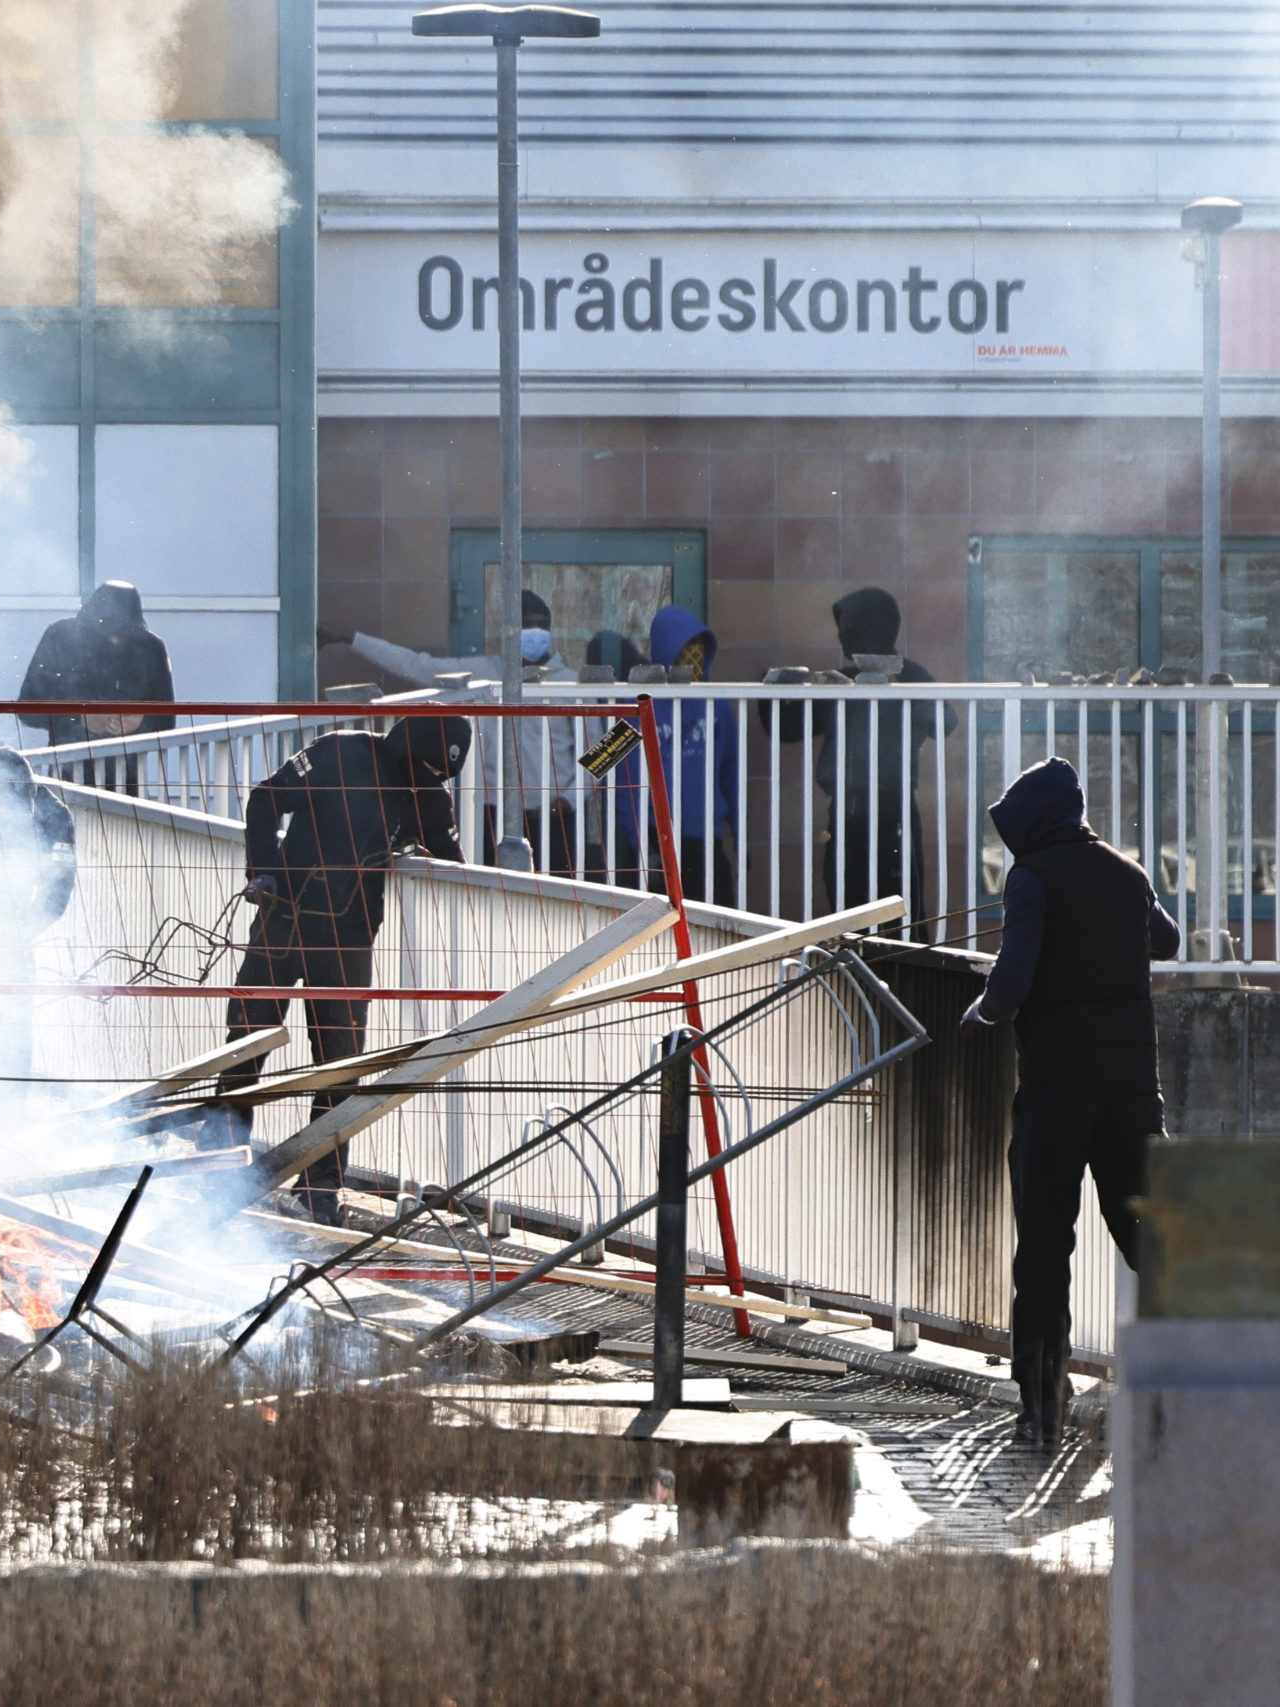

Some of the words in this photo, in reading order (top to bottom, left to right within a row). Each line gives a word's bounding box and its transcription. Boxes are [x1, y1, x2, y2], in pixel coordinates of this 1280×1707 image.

[418, 252, 1026, 334] Områdeskontor
[978, 344, 996, 356] DU
[1020, 344, 1068, 357] HEMMA
